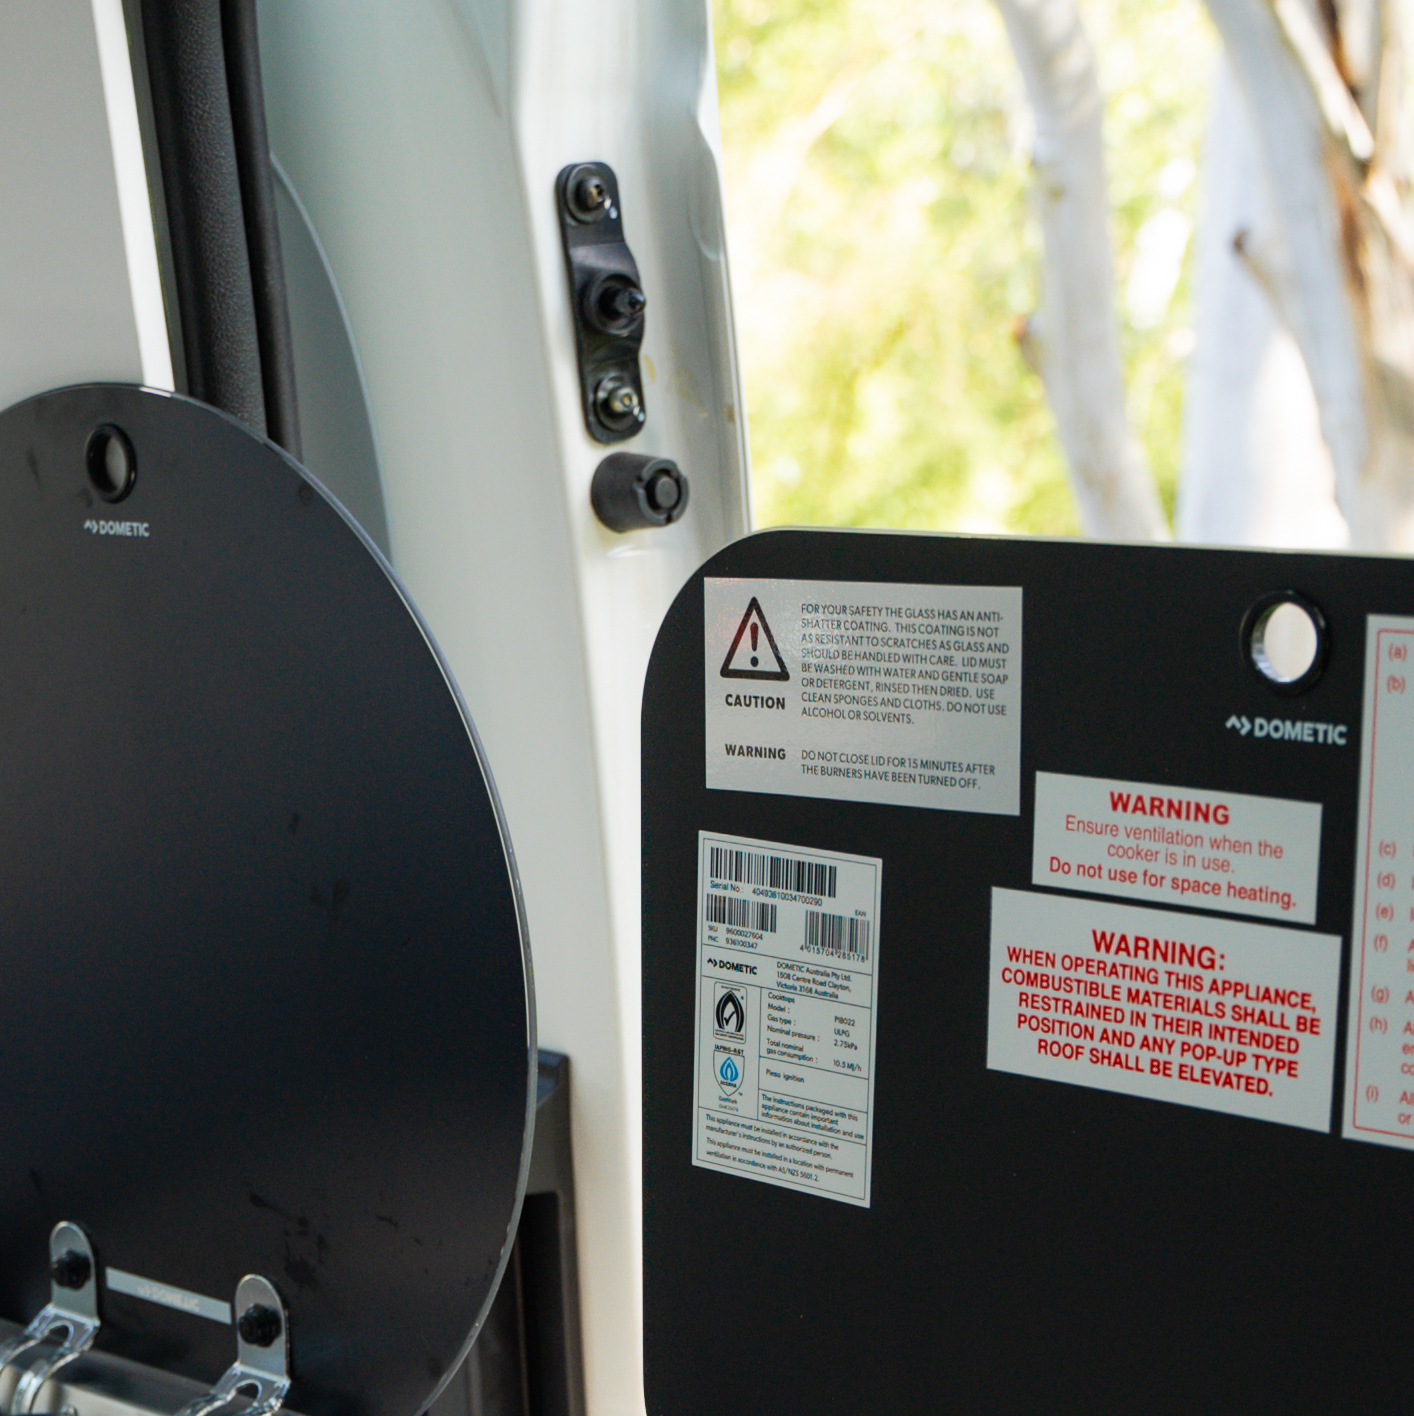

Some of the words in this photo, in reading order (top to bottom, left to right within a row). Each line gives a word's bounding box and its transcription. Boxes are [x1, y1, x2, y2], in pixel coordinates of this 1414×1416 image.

[95, 520, 149, 536] DOMETIC
[801, 603, 819, 613] FOR
[820, 604, 847, 615] YOUR
[848, 605, 883, 616] SAFETY
[884, 606, 903, 618] THE
[904, 607, 935, 619] GLASS
[937, 609, 958, 621] HAS
[958, 609, 974, 621] AN
[975, 610, 1003, 622] ANTI-
[801, 617, 841, 629] SHATTER
[843, 619, 891, 632] COATING.
[894, 621, 917, 634] THIS
[917, 623, 965, 636] COATING
[965, 625, 975, 637] IS
[976, 625, 999, 638] NOT
[1387, 643, 1408, 662] (a)
[801, 662, 812, 672] BE
[813, 663, 855, 675] WASHED
[855, 665, 881, 676] WITH
[882, 667, 916, 678] WATER
[917, 669, 939, 680] AND
[940, 669, 979, 683] GENTLE
[980, 672, 1009, 684] SOAP
[801, 677, 814, 687] OR
[814, 677, 873, 694] DETERGENT,
[875, 681, 910, 693] RINSED
[911, 683, 937, 695] THEN
[939, 685, 972, 698] DRIED.
[975, 687, 995, 700] USE
[724, 693, 785, 710] CAUTION
[801, 691, 831, 703] CLEAN
[833, 693, 878, 706] SPONGES
[879, 697, 901, 708] AND
[902, 698, 944, 711] CLOTHS.
[946, 700, 963, 712] DO
[963, 702, 986, 714] NOT
[986, 703, 1007, 716] USE
[801, 706, 846, 719] ALCOHOL
[847, 709, 861, 720] OR
[862, 710, 914, 724] SOLVENTS.
[1250, 717, 1347, 744] DOMETIC
[724, 743, 786, 760] WARNING
[801, 749, 815, 760] DO
[817, 751, 837, 762] NOT
[838, 752, 869, 765] CLOSE
[870, 755, 885, 766] LID
[886, 756, 906, 768] FOR
[907, 757, 918, 769] 15
[919, 758, 963, 773] MINUTES
[964, 762, 995, 776] AFTER
[801, 763, 818, 775] THE
[820, 765, 862, 779] BURNERS
[863, 769, 889, 781] HAVE
[891, 771, 916, 783] BEEN
[917, 773, 957, 787] TURNED
[957, 776, 980, 789] OFF.
[1109, 791, 1229, 825] WARNING
[1065, 813, 1119, 837] Ensure
[1123, 825, 1203, 847] ventilation
[1208, 834, 1252, 854] when
[1257, 839, 1283, 859] the
[1106, 843, 1160, 862] cooker
[1164, 847, 1177, 865] is
[1182, 849, 1196, 868] in
[1201, 856, 1234, 873] use.
[1378, 841, 1397, 859] (c)
[709, 879, 729, 890] Serial
[1049, 855, 1071, 874] Do
[1076, 863, 1102, 879] not
[1107, 868, 1137, 884] use
[1142, 868, 1166, 887] for
[1170, 876, 1221, 896] space
[1226, 880, 1296, 910] heating.
[1091, 929, 1225, 970] WARNING:
[718, 959, 758, 975] DOMETIC
[776, 961, 804, 973] DOMETIC
[805, 966, 830, 977] Australia
[830, 970, 840, 980] Pty
[1006, 945, 1055, 968] WHEN
[1060, 954, 1158, 984] OPERATING
[1164, 970, 1203, 992] THIS
[1207, 978, 1316, 1013] APPLIANCE,
[1001, 967, 1121, 1001] COMBUSTIBLE
[1126, 987, 1225, 1018] MATERIALS
[1231, 1004, 1290, 1030] SHALL
[1295, 1014, 1320, 1035] BE
[1018, 991, 1125, 1023] RESTRAINED
[1129, 1009, 1146, 1028] IN
[1151, 1013, 1203, 1037] THEIR
[1208, 1023, 1299, 1054] INTENDED
[1017, 1012, 1094, 1040] POSITION
[1098, 1027, 1135, 1048] AND
[1139, 1034, 1175, 1054] ANY
[1180, 1040, 1247, 1066] POP-UP
[1251, 1053, 1298, 1078] TYPE
[1037, 1038, 1084, 1060] ROOF
[1089, 1047, 1144, 1072] SHALL
[1149, 1058, 1172, 1077] BE
[1177, 1063, 1273, 1096] ELEVATED.
